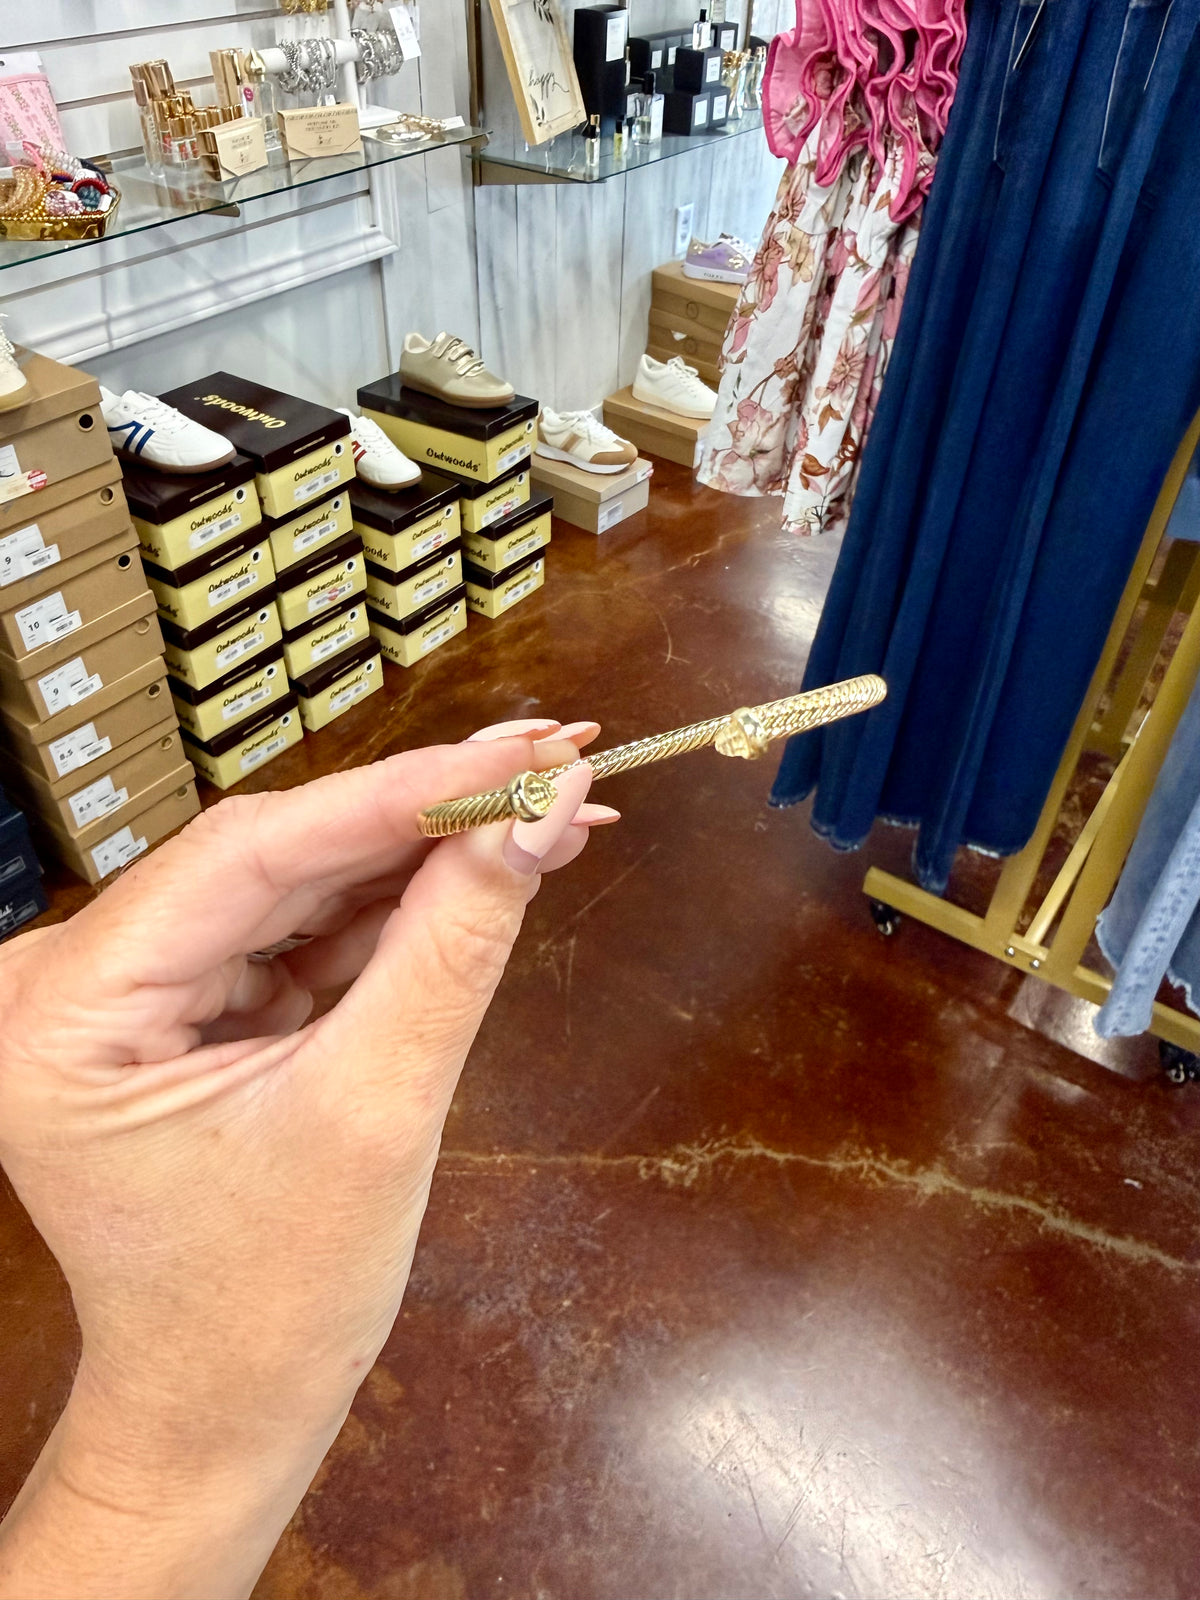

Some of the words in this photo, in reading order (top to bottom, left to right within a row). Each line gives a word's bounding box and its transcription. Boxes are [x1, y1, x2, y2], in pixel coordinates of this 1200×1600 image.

[201, 394, 287, 429] Outwoods
[294, 457, 333, 482] Outwoods
[426, 448, 479, 472] Outwoods
[190, 503, 233, 531] Outwoods
[293, 512, 330, 537] Outwoods
[208, 566, 250, 594] Outwoods
[307, 573, 344, 597] Outwoods
[28, 621, 40, 631] 10
[311, 622, 347, 647] Outwoods
[216, 625, 257, 653] Outwoods
[223, 679, 264, 707] Outwoods
